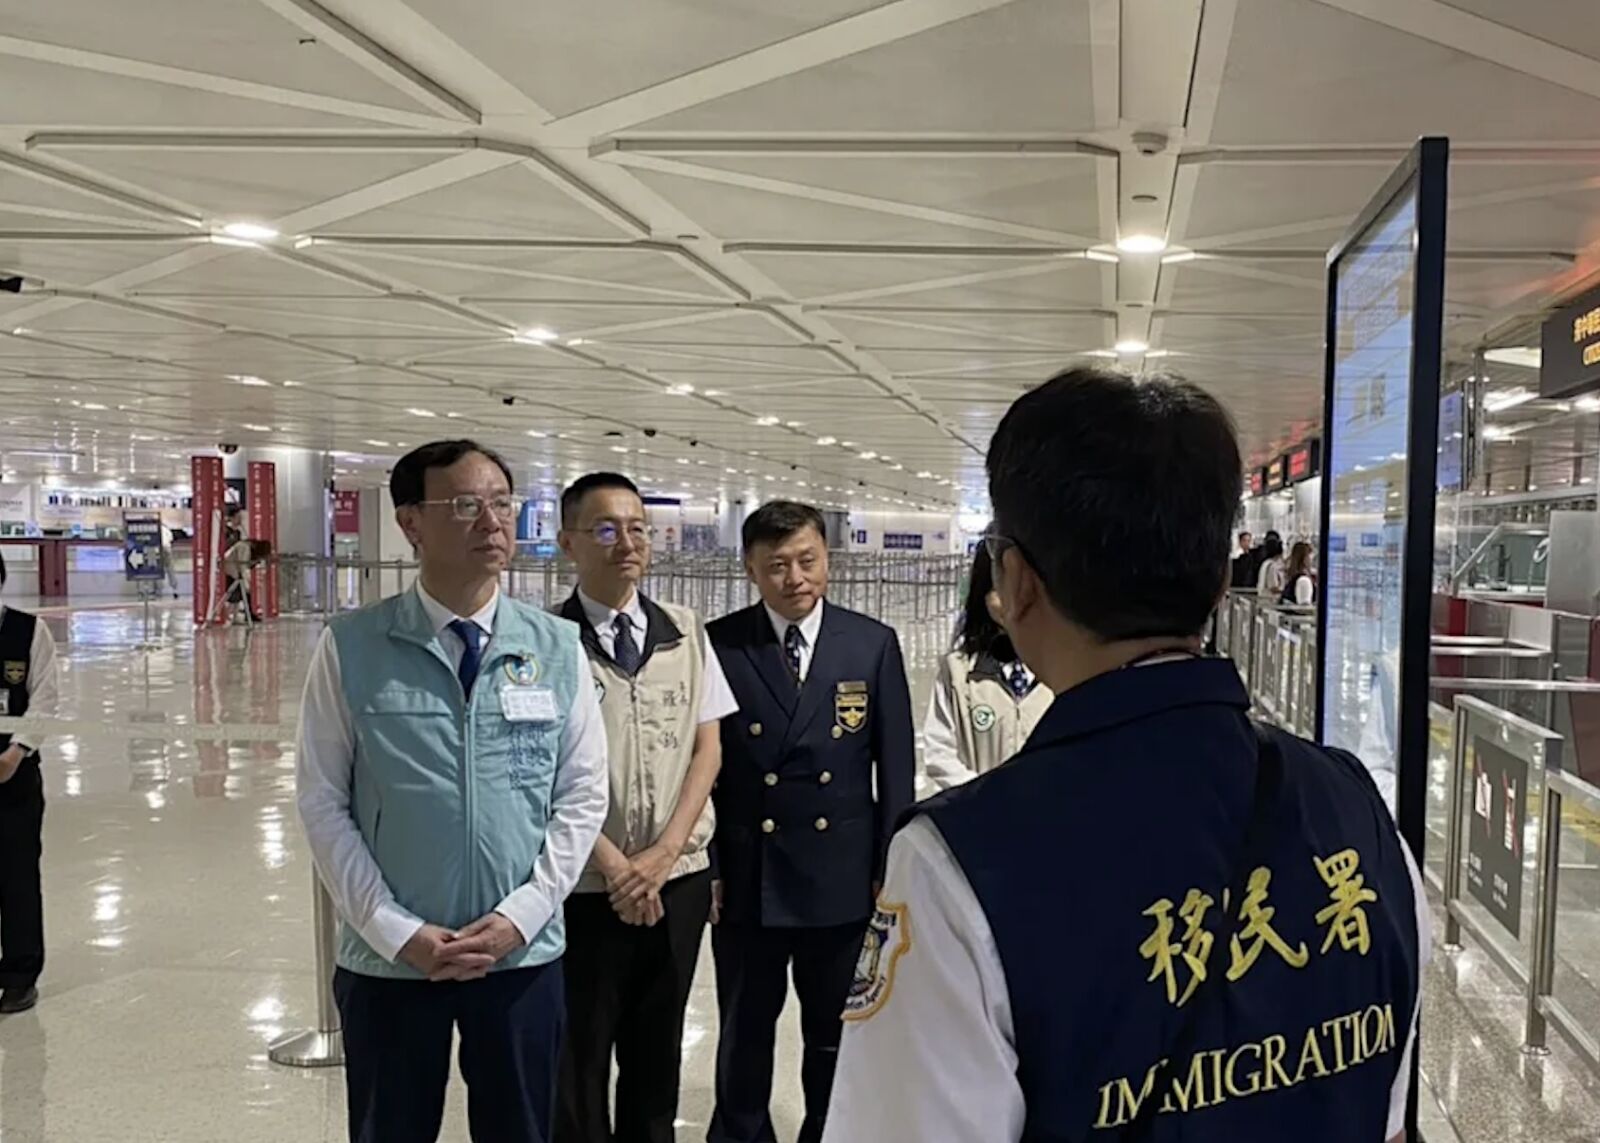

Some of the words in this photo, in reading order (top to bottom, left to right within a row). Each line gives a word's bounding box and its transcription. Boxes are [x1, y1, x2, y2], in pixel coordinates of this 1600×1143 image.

[1139, 848, 1377, 1007] 移民署
[1092, 1004, 1396, 1129] IMMIGRATION
